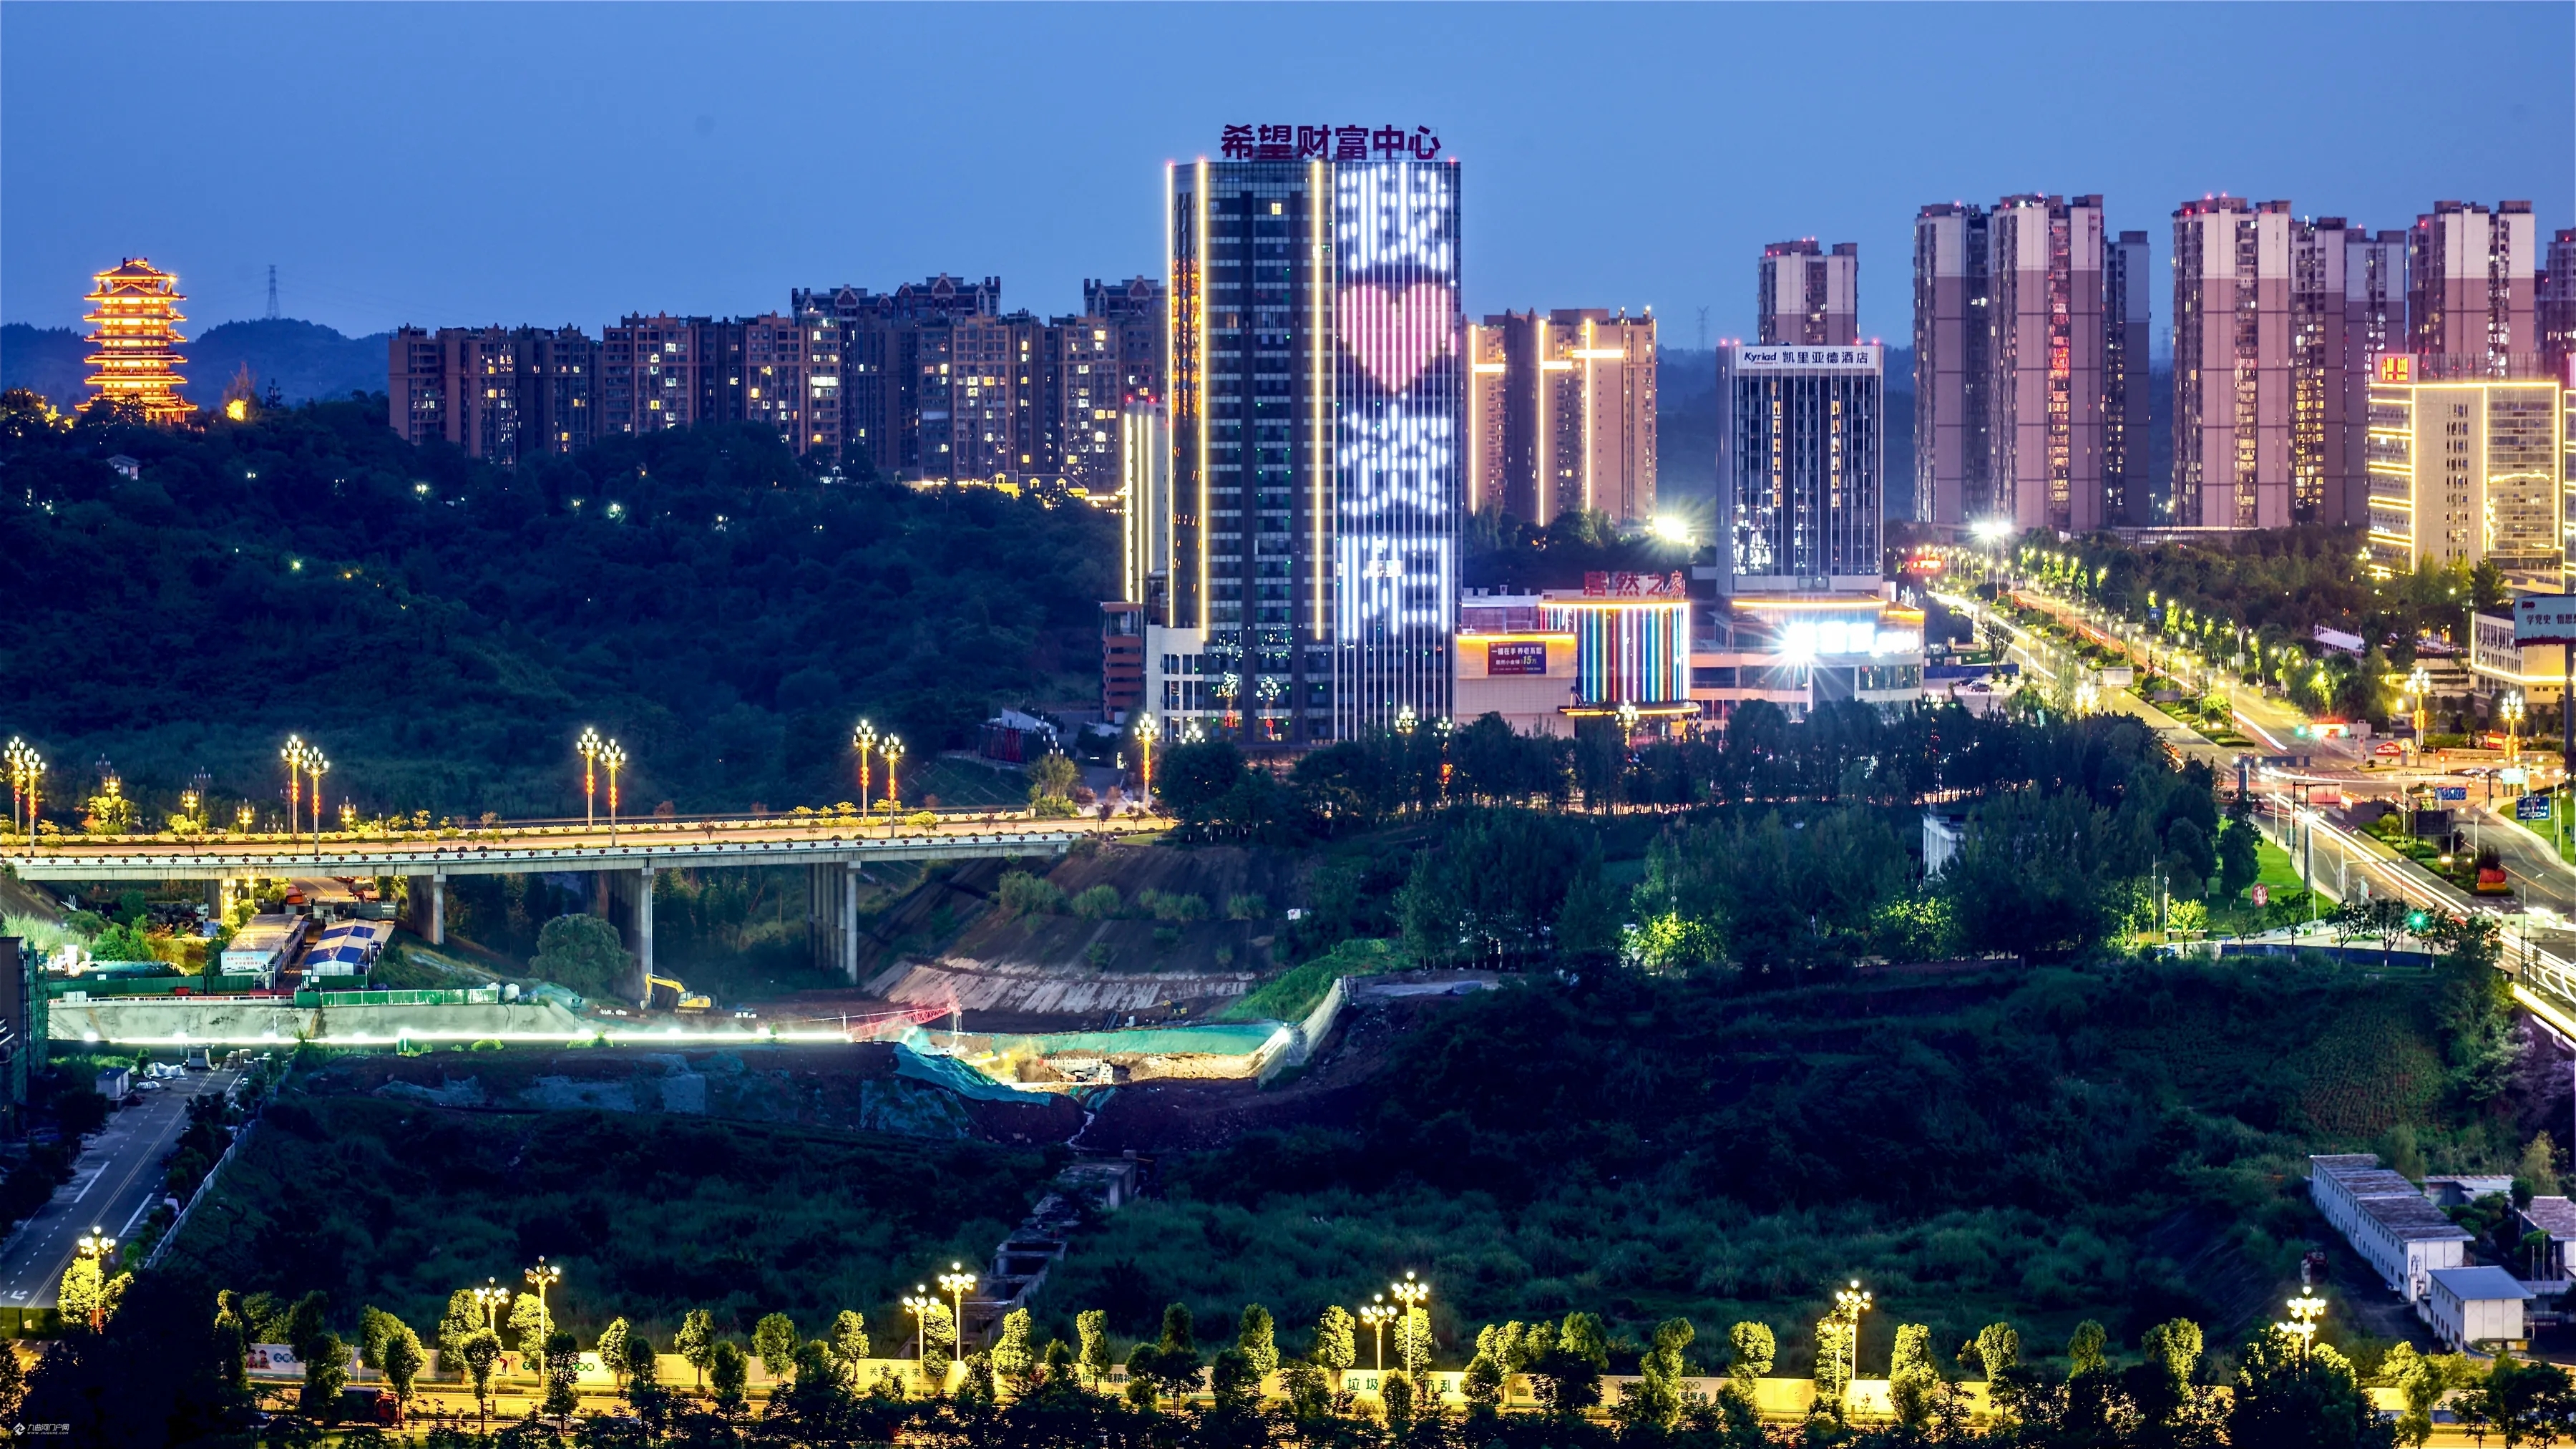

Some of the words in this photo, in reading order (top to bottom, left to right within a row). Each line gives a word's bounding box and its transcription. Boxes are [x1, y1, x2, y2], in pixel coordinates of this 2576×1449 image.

[1221, 124, 1441, 160] 希望财富中心
[1744, 352, 1777, 363] Kyriad
[1782, 351, 1868, 364] 凯里亚德酒店
[1583, 570, 1685, 597] 居然之家
[2527, 614, 2551, 625] 学党史
